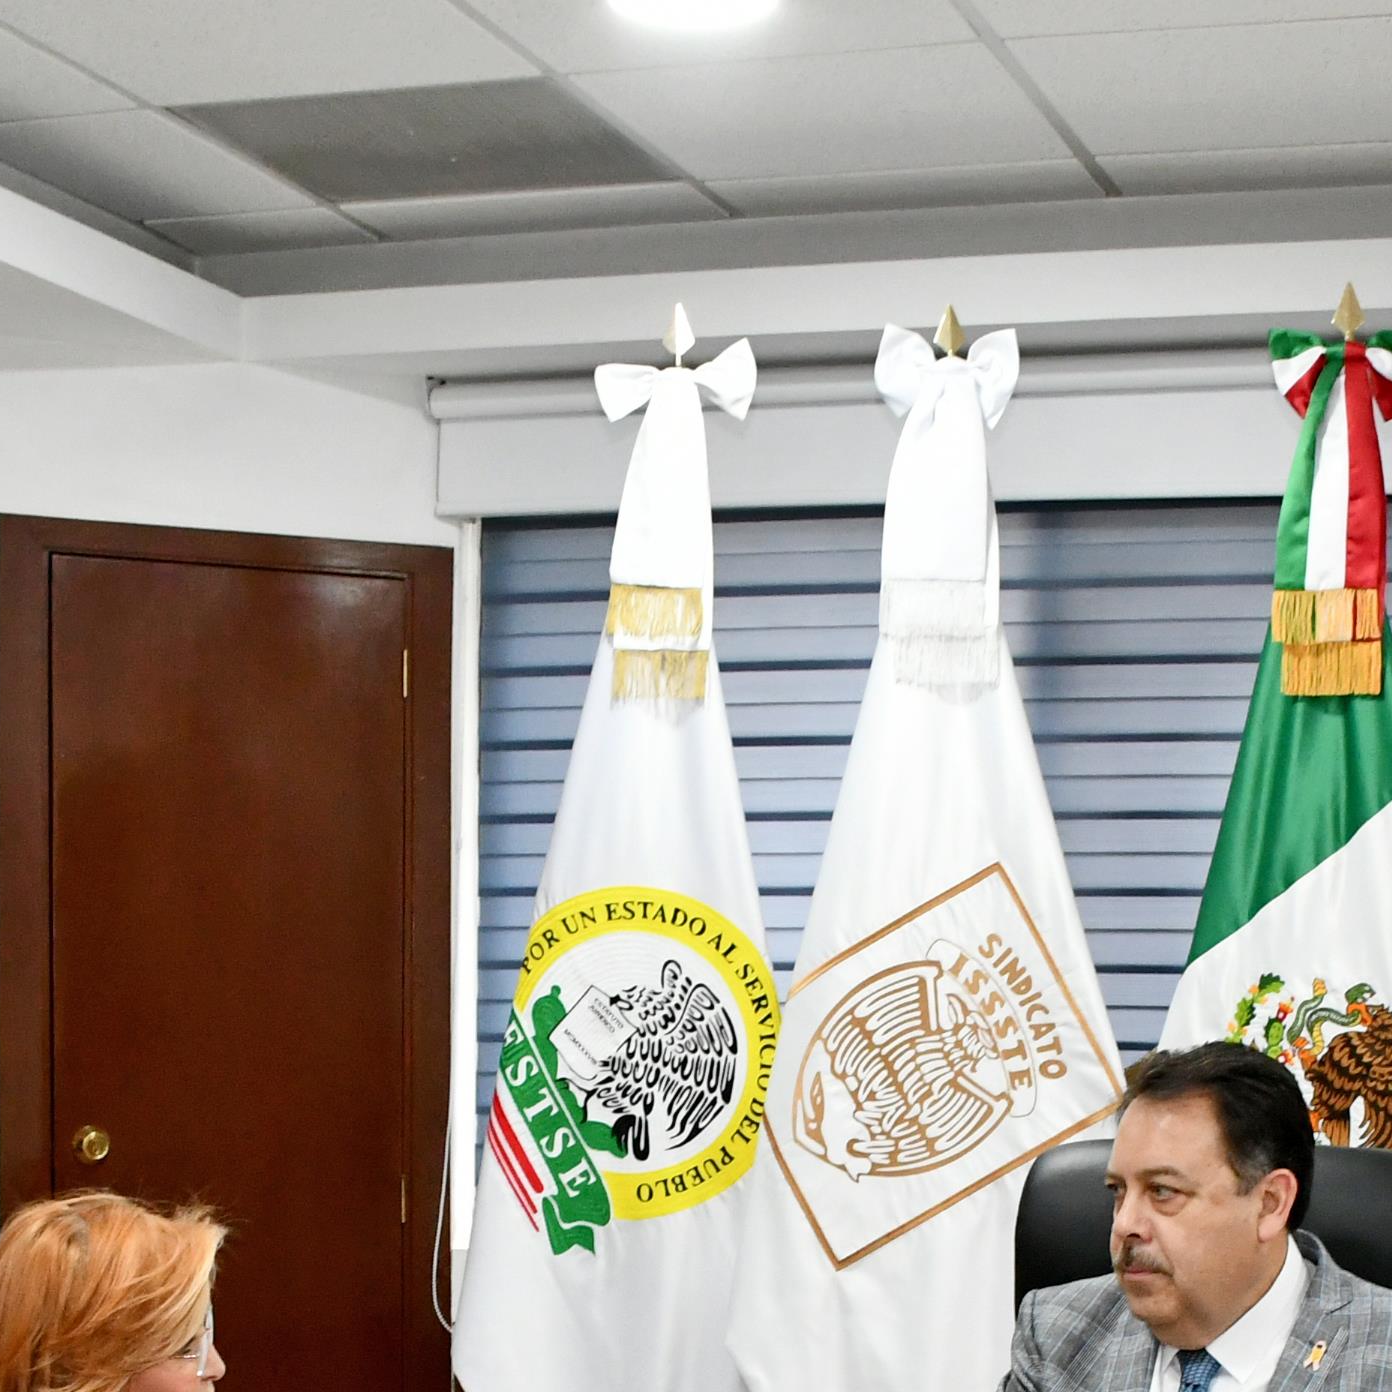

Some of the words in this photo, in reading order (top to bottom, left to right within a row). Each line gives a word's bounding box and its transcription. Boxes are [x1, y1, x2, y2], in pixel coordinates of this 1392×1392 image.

[561, 907, 597, 934] UN
[607, 900, 707, 936] ESTADO
[521, 929, 560, 975] POR
[707, 930, 737, 964] AL
[949, 953, 1033, 1090] ISSSTE
[978, 934, 1068, 1079] SINDICATO
[730, 1098, 765, 1145] DEL
[636, 1146, 735, 1202] PUEBLO
